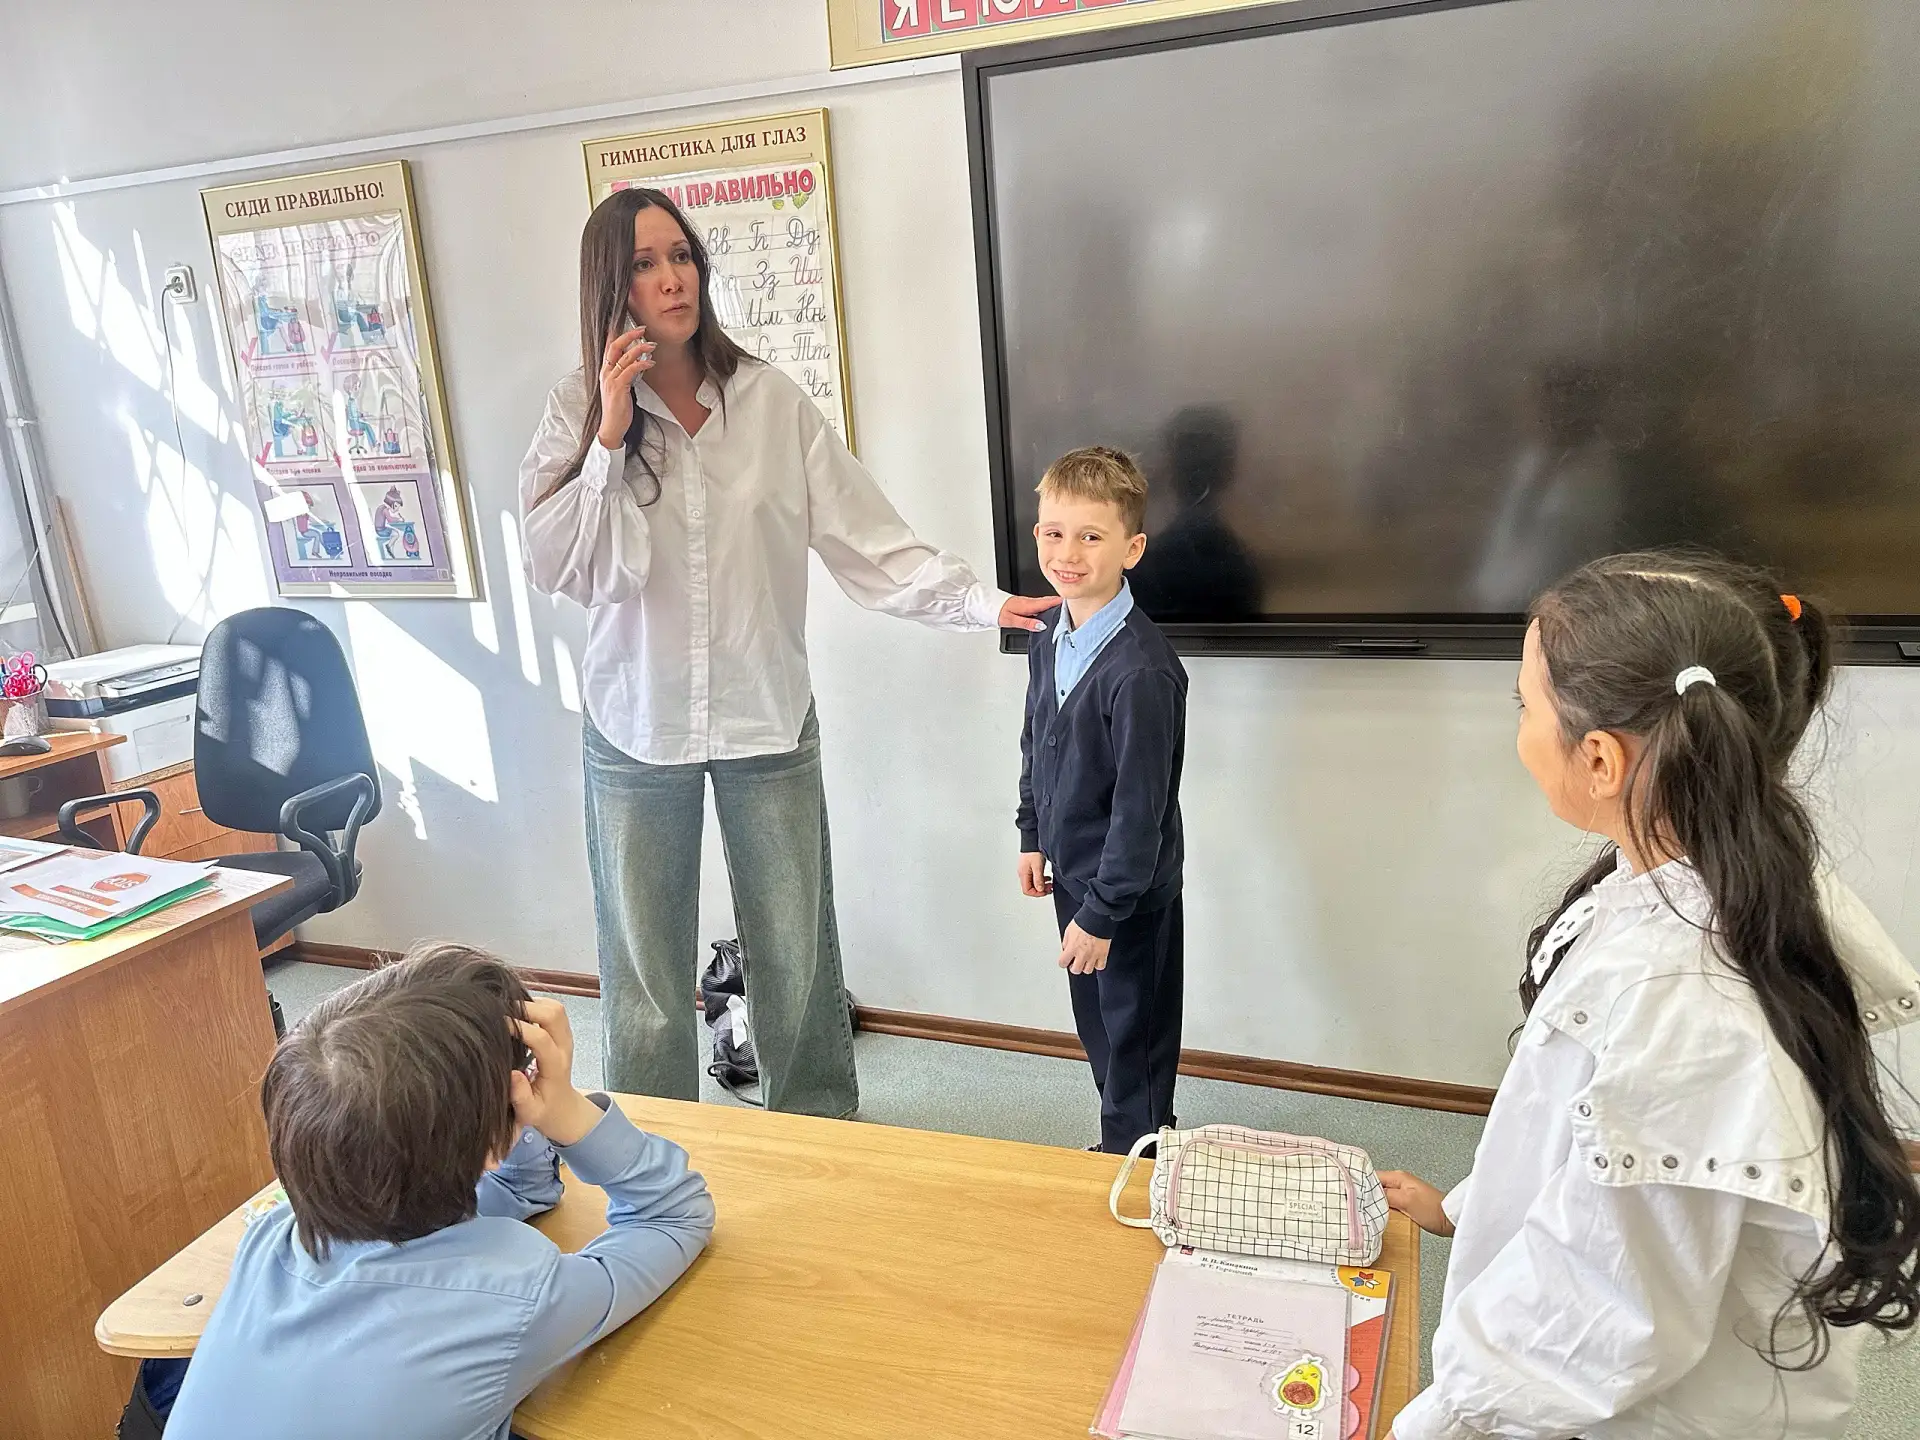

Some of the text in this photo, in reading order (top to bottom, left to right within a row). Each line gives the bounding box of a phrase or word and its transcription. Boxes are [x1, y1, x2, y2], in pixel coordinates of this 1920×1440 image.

[600, 126, 807, 167] ГИМНАСТИКА ДЛЯ ГЛАЗ
[225, 181, 385, 218] СИДИ ПРАВИЛЬНО!
[685, 168, 815, 208] ПРАВИЛЬНО
[1289, 1201, 1318, 1211] SPECIAL
[1227, 1313, 1264, 1324] ТЕТРАДЬ
[1295, 1423, 1316, 1437] 12
